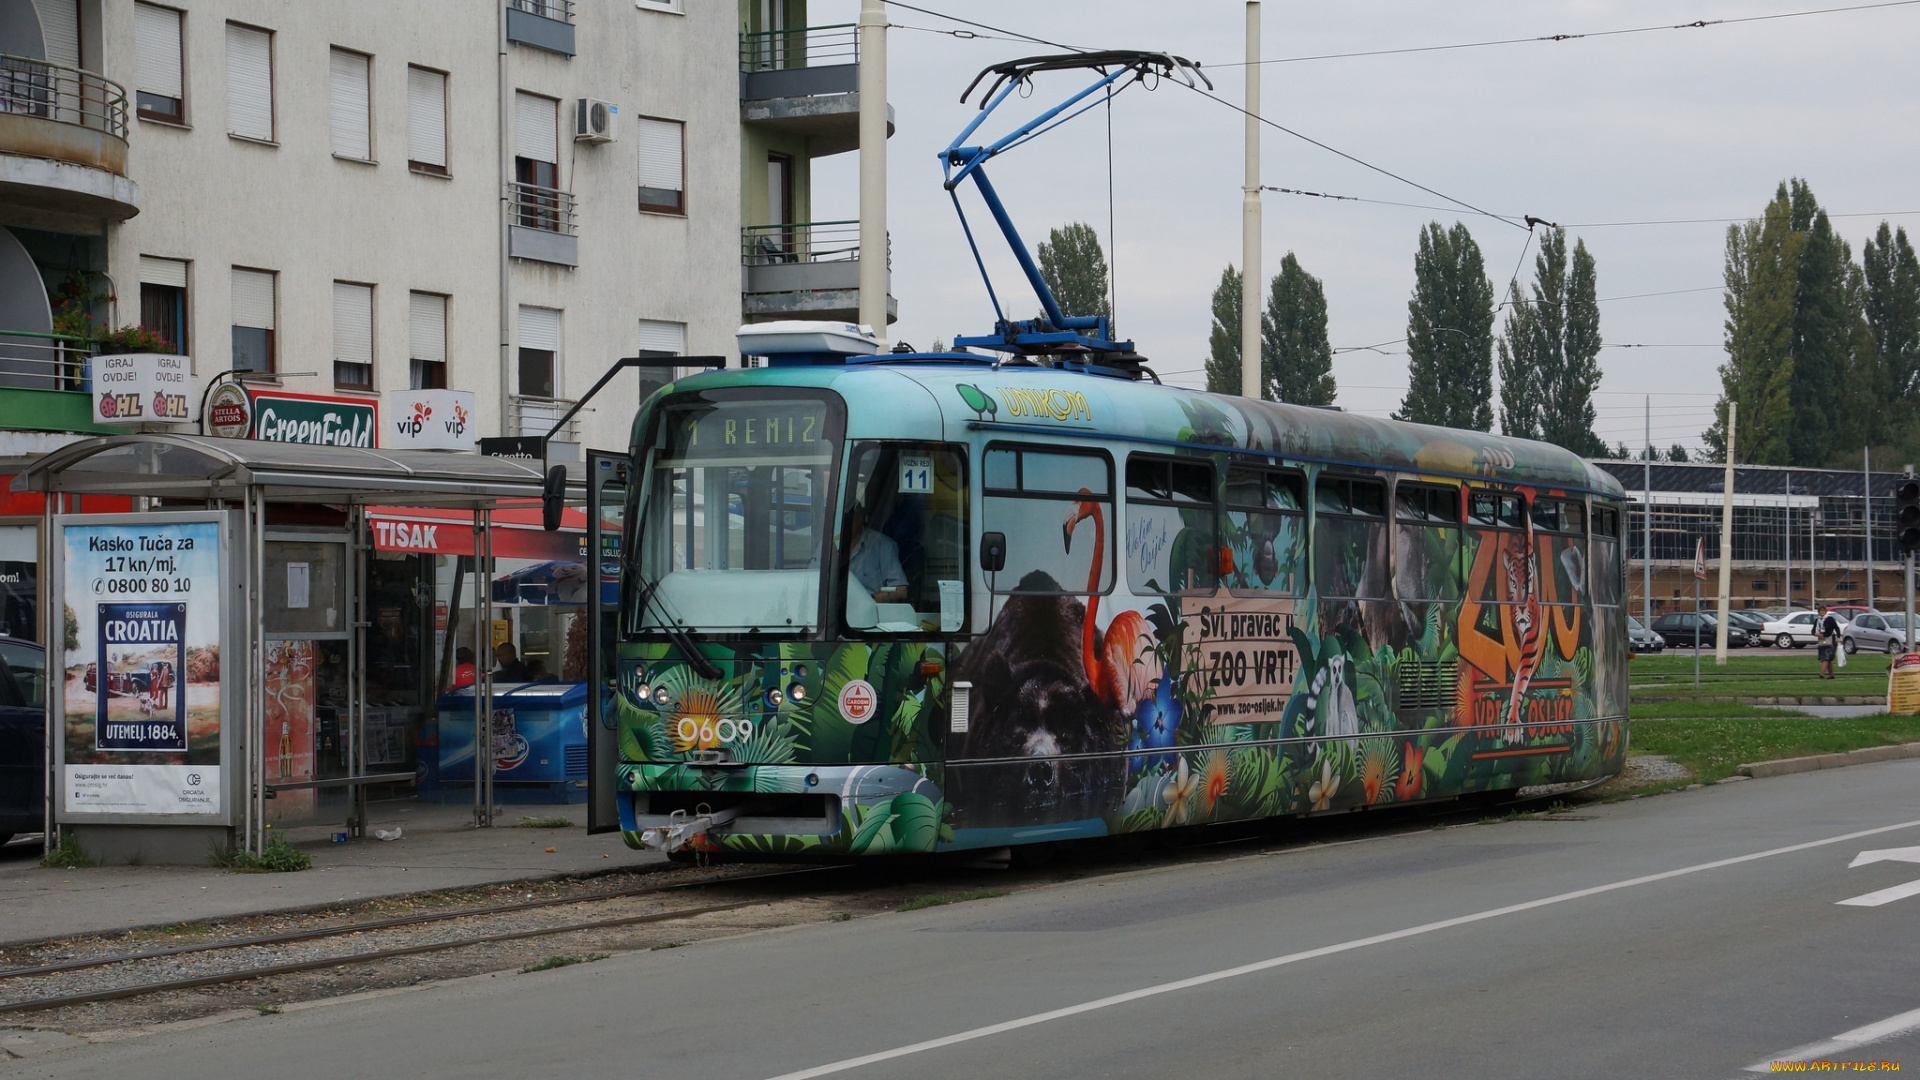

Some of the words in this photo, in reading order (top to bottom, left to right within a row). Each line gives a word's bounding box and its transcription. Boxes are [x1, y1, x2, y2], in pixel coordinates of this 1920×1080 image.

[105, 358, 134, 369] IGRAJ
[157, 358, 181, 369] IGRAJ
[102, 371, 137, 383] OVDJE!
[155, 371, 184, 383] OVDJE!
[214, 408, 241, 416] STELLA
[996, 386, 1092, 421] UNIKOM
[214, 414, 241, 423] ARTOIS
[259, 407, 372, 448] GreenField
[397, 416, 422, 438] vip
[445, 416, 464, 438] vip
[688, 420, 698, 446] 1
[725, 416, 816, 445] REMIZ
[905, 469, 927, 489] 11
[89, 536, 134, 552] Kasko
[138, 534, 173, 552] Tuča
[177, 538, 194, 551] za
[376, 522, 438, 549] TISAK
[602, 548, 622, 558] USLUG
[105, 557, 125, 573] 17
[128, 556, 177, 575] kn/mj.
[108, 578, 147, 593] 0800
[151, 578, 169, 593] 80
[174, 577, 191, 592] 10
[125, 611, 159, 619] OSIGURALA
[1200, 605, 1228, 640] Svi,
[1231, 614, 1281, 641] pravac
[105, 620, 178, 641] CROATIA
[1209, 651, 1247, 687] ZOO
[1253, 650, 1294, 685] VRT!
[1475, 698, 1502, 740] VRT
[677, 717, 753, 743] 0609
